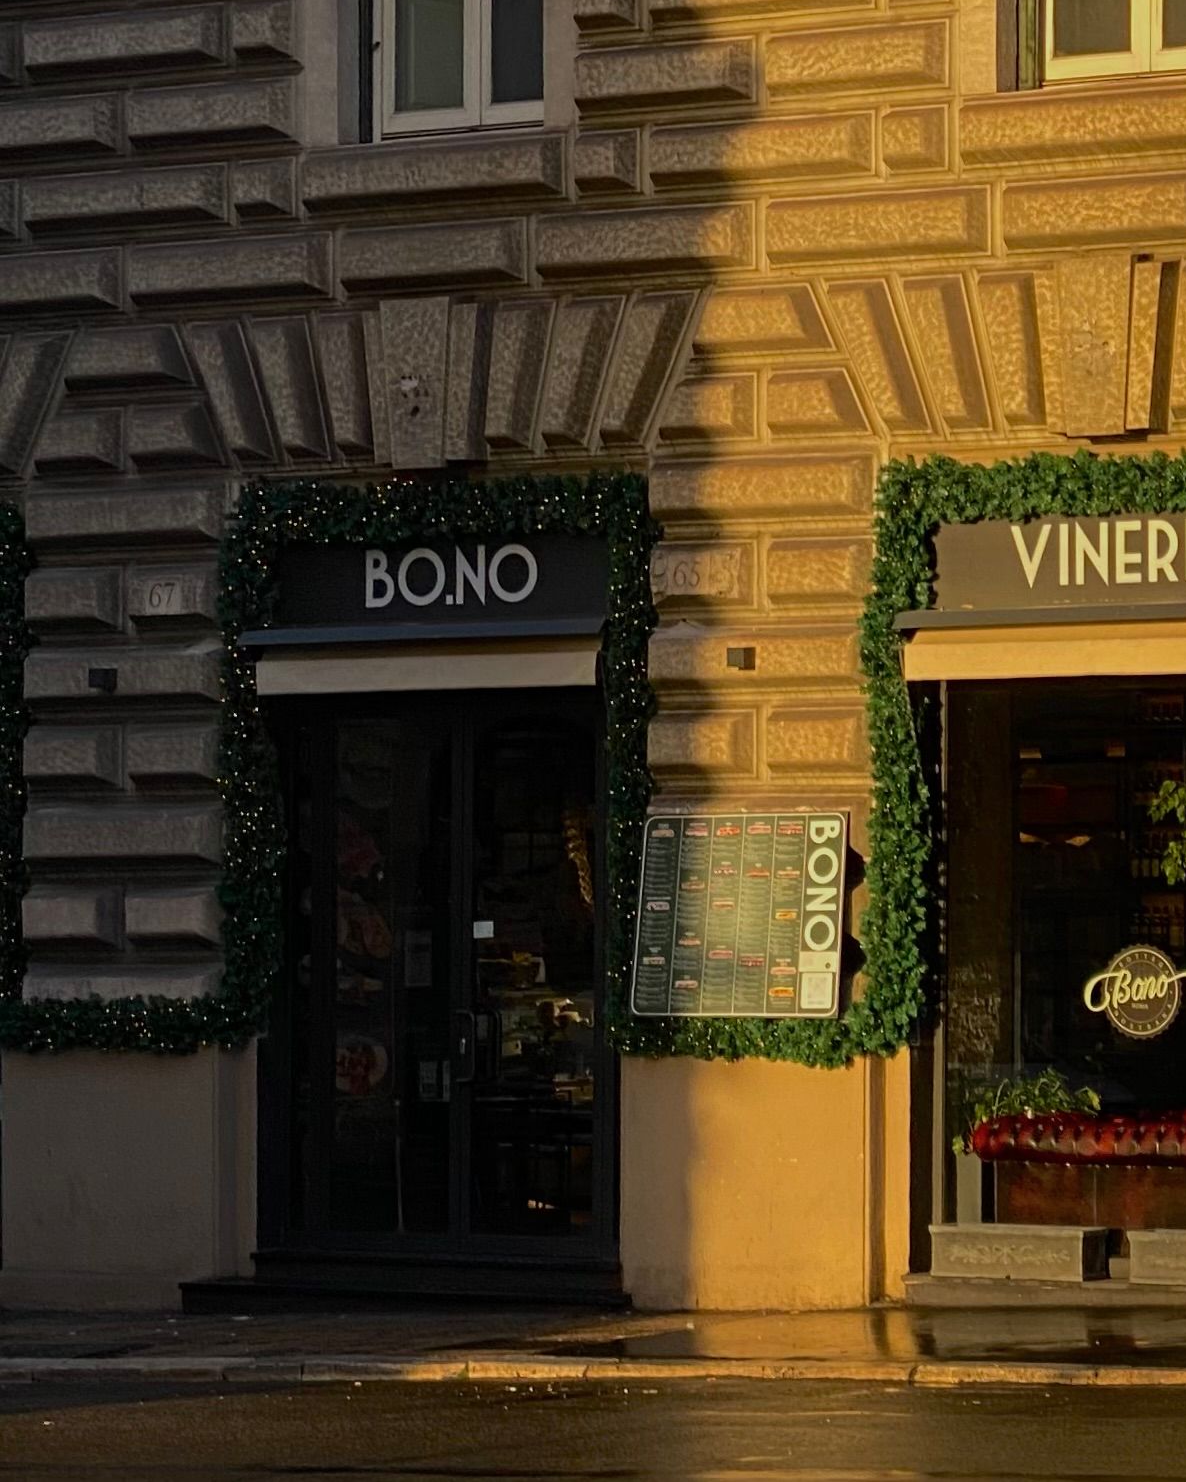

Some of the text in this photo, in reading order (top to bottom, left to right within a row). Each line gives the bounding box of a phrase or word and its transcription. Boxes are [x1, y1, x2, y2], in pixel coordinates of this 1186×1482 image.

[149, 582, 176, 608] 67
[365, 543, 538, 609] BO.NO
[673, 560, 700, 587] 65
[804, 820, 840, 951] BONO
